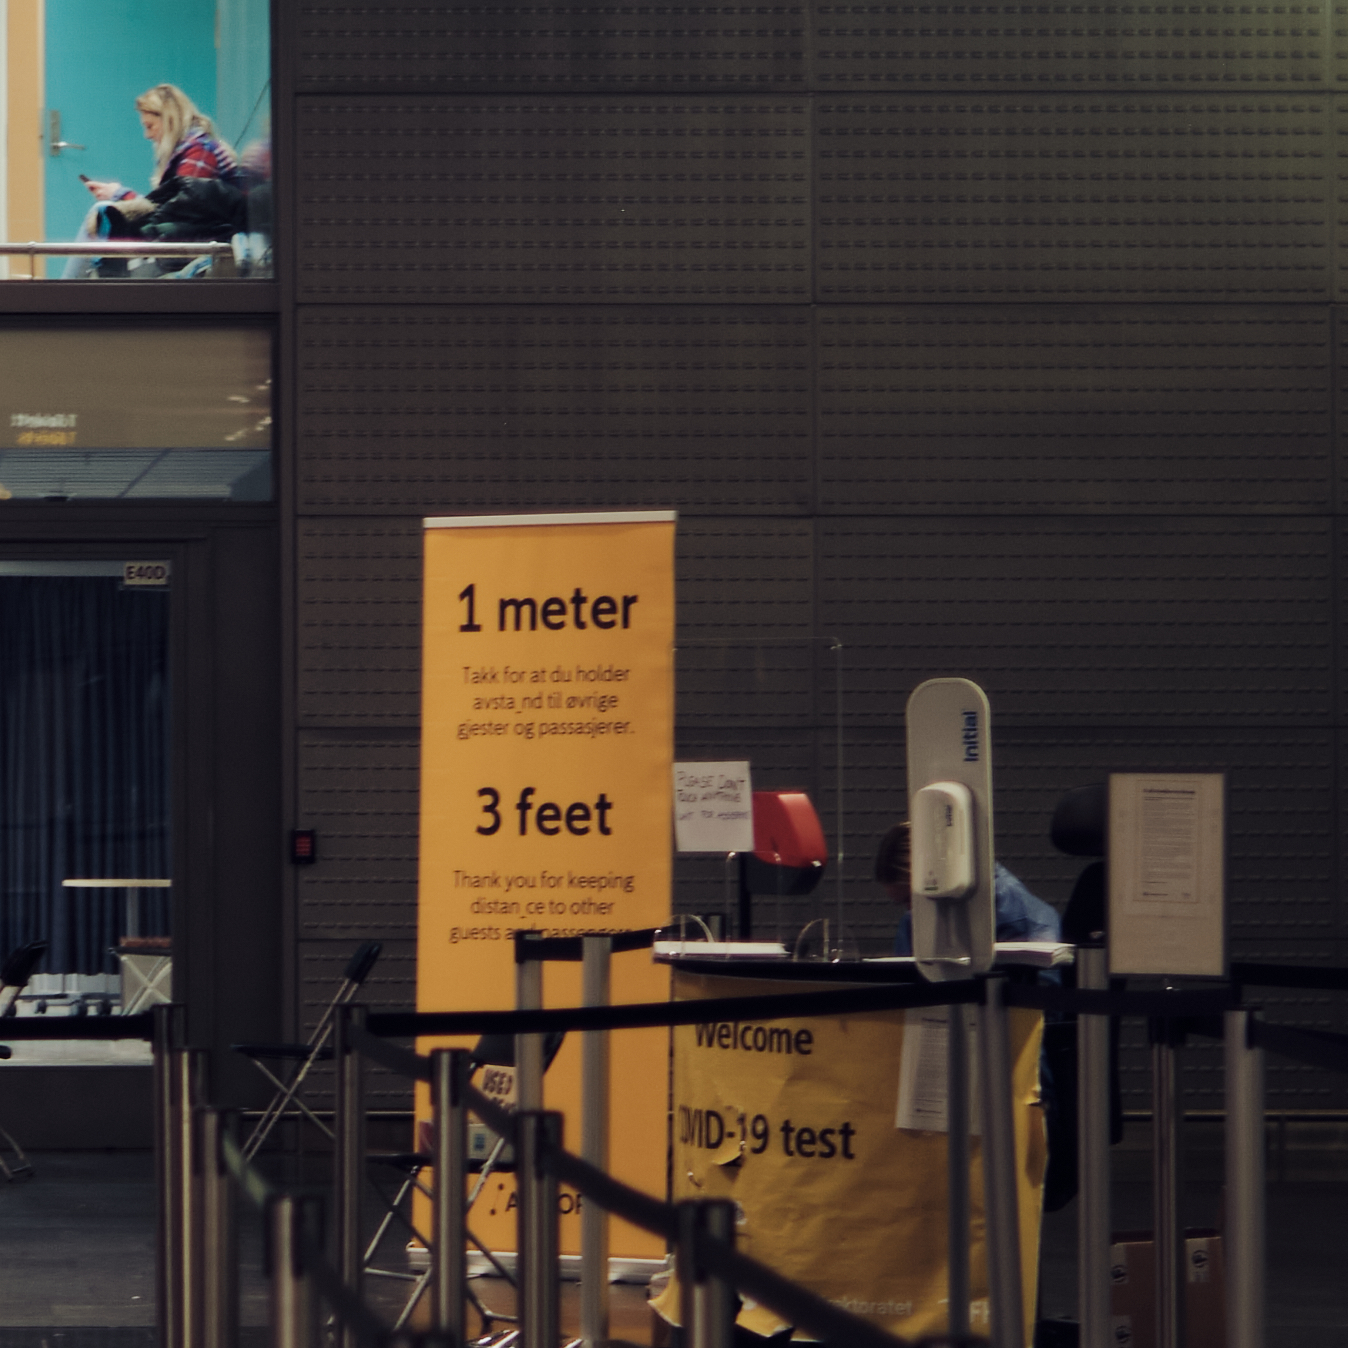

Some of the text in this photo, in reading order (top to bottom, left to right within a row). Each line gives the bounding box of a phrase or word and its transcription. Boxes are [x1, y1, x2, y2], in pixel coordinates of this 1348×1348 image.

[458, 583, 638, 633] 1 meter
[462, 664, 630, 684] Takk for at du holder
[547, 692, 562, 709] til
[565, 691, 619, 713] øvrige
[457, 717, 635, 740] gjester og passasjerer.
[962, 710, 980, 762] Initial
[476, 787, 613, 836] 3 feet
[453, 870, 635, 893] Thank you for keeping
[549, 899, 567, 914] to
[570, 897, 615, 915] other
[449, 926, 501, 943] guests
[695, 1022, 814, 1055] Welcome
[780, 1119, 857, 1160] test
